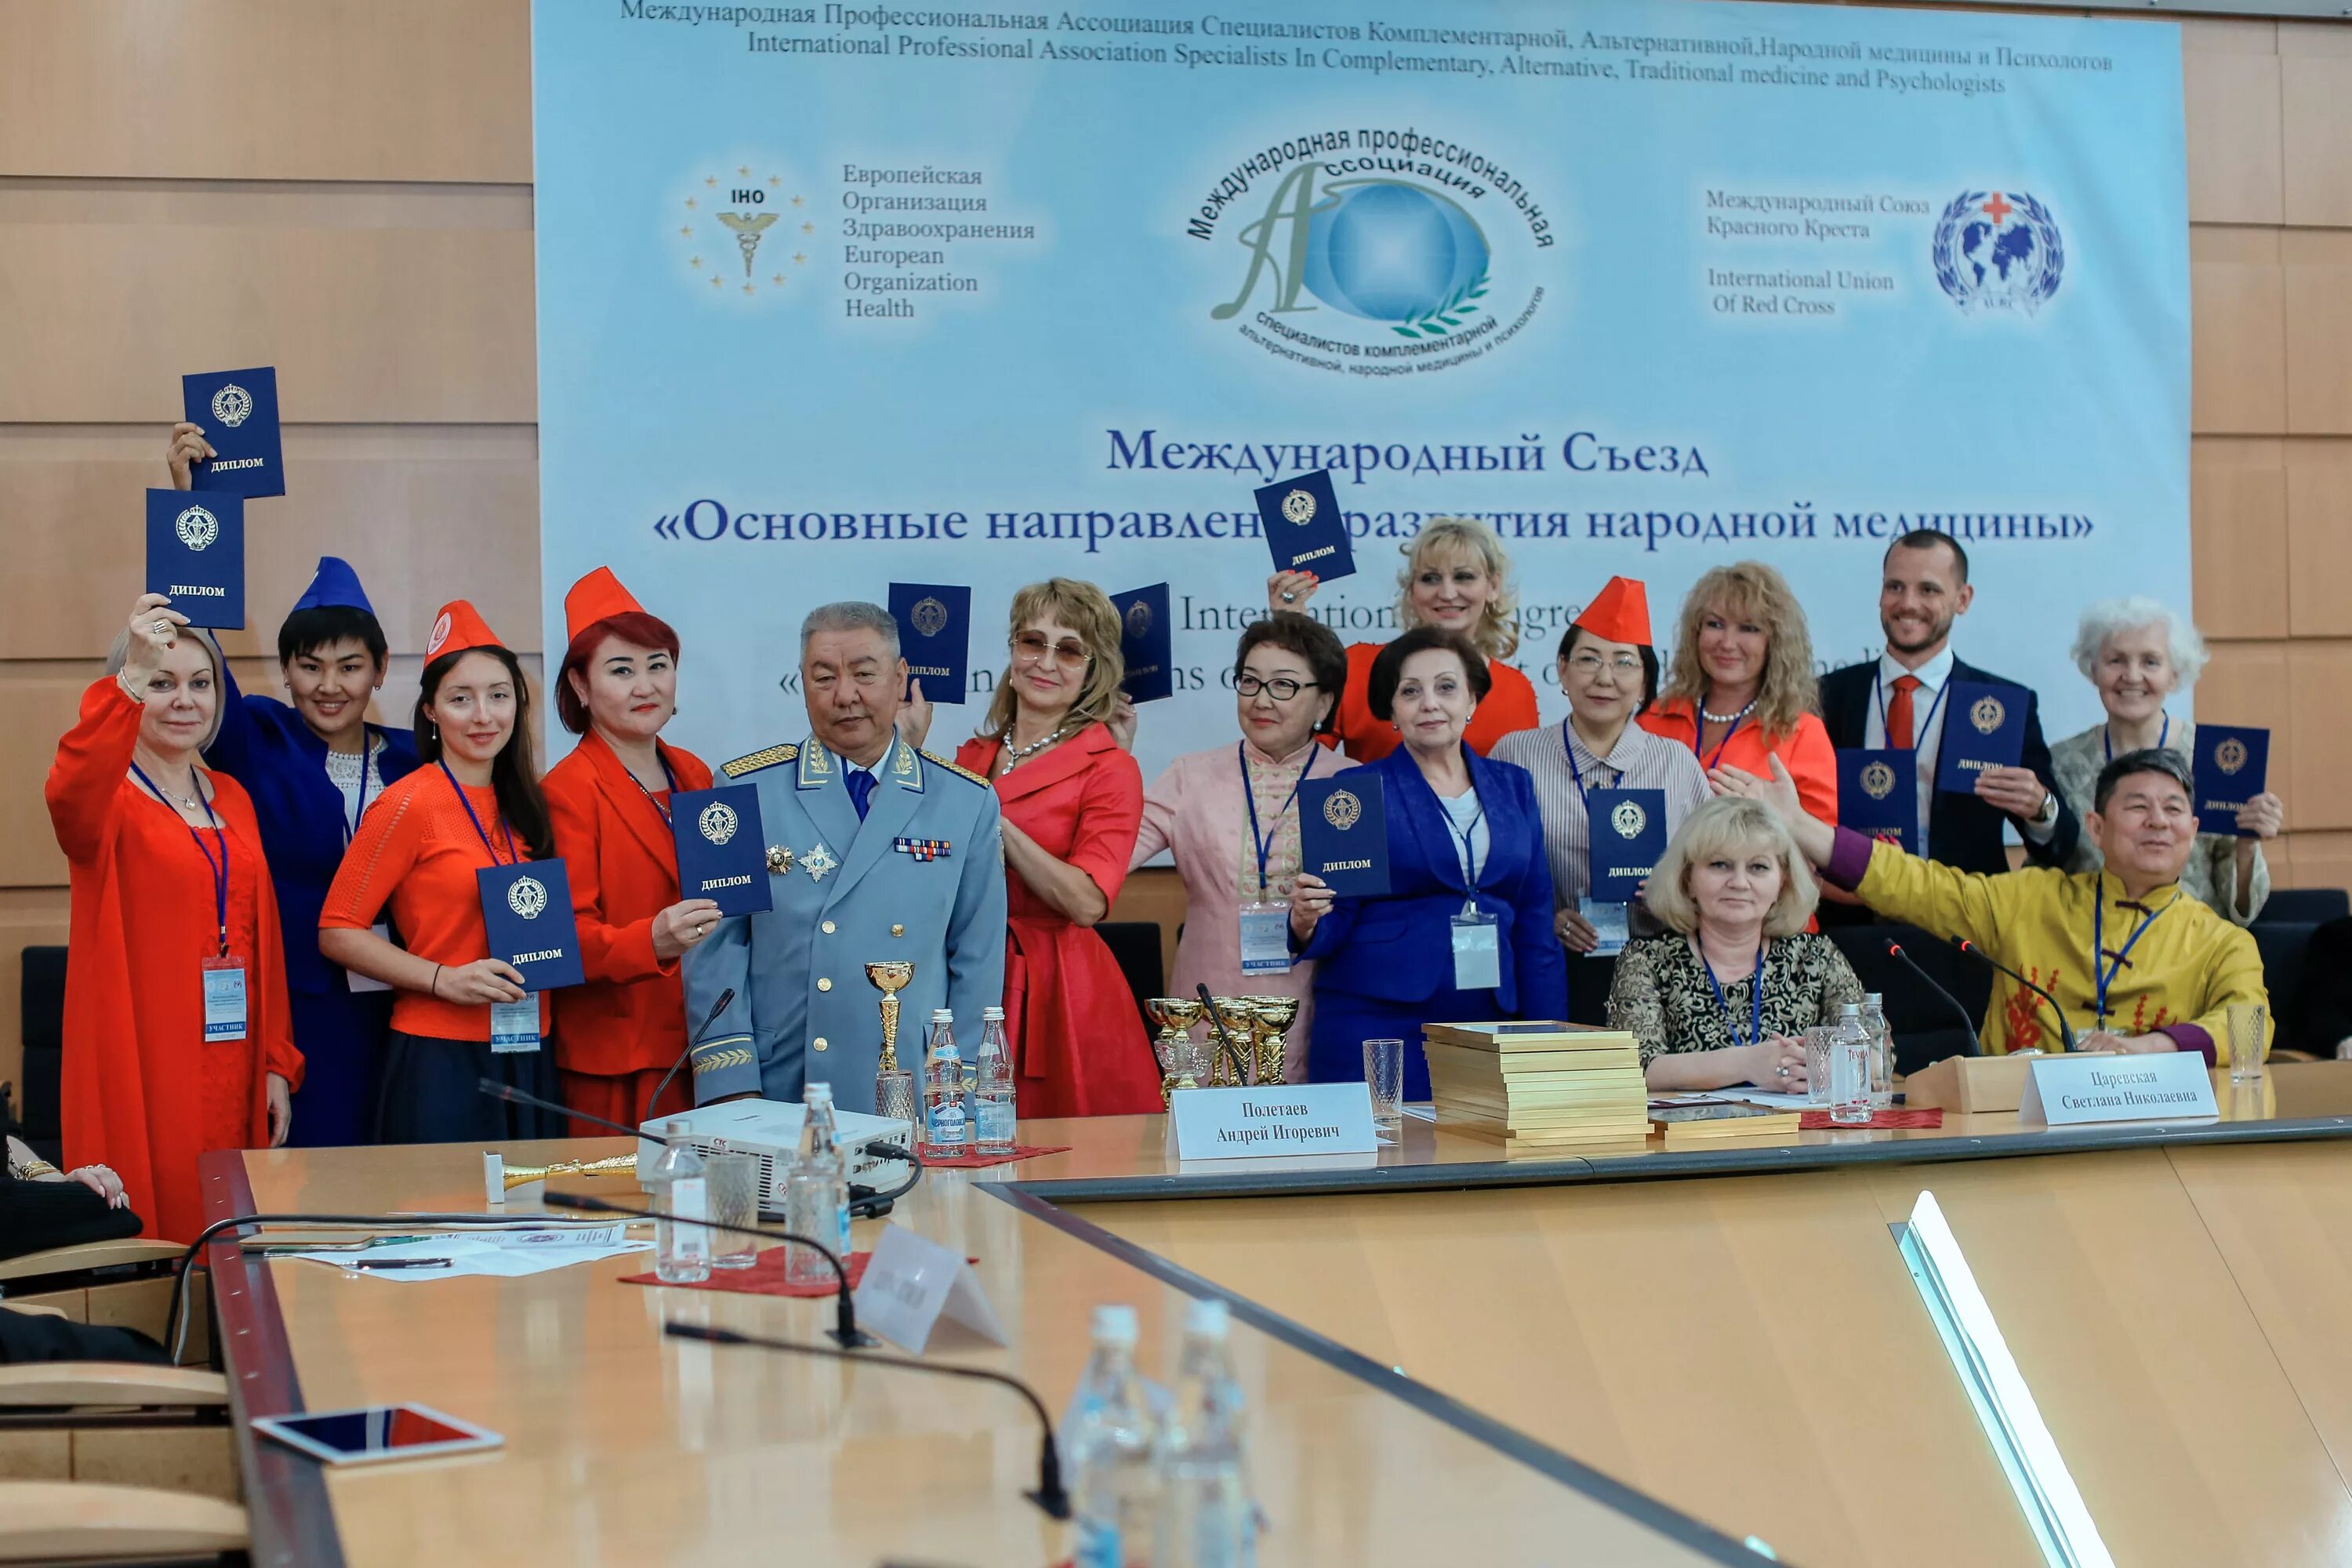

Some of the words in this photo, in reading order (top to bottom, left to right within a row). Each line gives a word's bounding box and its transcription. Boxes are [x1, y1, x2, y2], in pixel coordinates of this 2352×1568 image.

[621, 1, 815, 26] Международная
[825, 3, 1048, 31] Профессиональная
[1057, 12, 1193, 34] Ассоциация
[1201, 16, 1361, 40] Специалистов
[1369, 22, 1573, 51] Комплементарной,
[1869, 47, 1971, 65] медицины
[1979, 53, 1990, 65] и
[1995, 46, 2112, 71] Психологов
[748, 31, 890, 55] International
[898, 35, 1032, 58] Professional
[1040, 40, 1167, 63] Association
[1175, 44, 1288, 69] Specialists
[1296, 48, 1316, 67] In
[1323, 49, 1494, 78] Complementary,
[1501, 55, 1618, 79] Alternative,
[1625, 58, 1733, 82] Traditional
[1740, 65, 1828, 86] medicine
[1836, 68, 1870, 87] and
[1876, 69, 2005, 96] Psychologists
[843, 165, 982, 188] Европейская
[731, 189, 764, 205] IHO
[1187, 129, 1350, 241] Международная
[1359, 127, 1555, 249] профессиональная
[843, 193, 987, 214] Организация
[1706, 190, 1874, 216] Международный
[1880, 194, 1930, 215] Союз
[843, 220, 1036, 241] Здравоохранения
[1706, 216, 1799, 239] Красного
[1805, 219, 1870, 241] Креста
[845, 245, 944, 267] European
[845, 272, 978, 294] Organization
[1708, 268, 1831, 289] International
[1838, 271, 1894, 290] Union
[846, 299, 915, 318] Health
[1714, 294, 1736, 314] Of
[1742, 294, 1778, 314] Red
[1784, 296, 1835, 314] Cross
[1256, 310, 1360, 357] специалистов
[1364, 315, 1498, 358] комплементарной
[1348, 361, 1413, 378] народной
[1417, 348, 1483, 374] медицины
[1494, 285, 1545, 347] психологов
[211, 457, 263, 473] ДИПЛОМ
[1107, 430, 1544, 484] Международный
[1562, 432, 1709, 477] Съезд
[653, 499, 968, 542] «Основные
[986, 510, 1262, 552] направлен
[1587, 500, 1816, 551] народной
[1833, 512, 2094, 543] медицины»
[1292, 546, 1335, 565] ДИПЛОМ
[169, 585, 225, 597] ДИПЛОМ
[1323, 859, 1370, 873] ДИПЛОМ
[702, 875, 751, 891] ДИПЛОМ
[512, 949, 562, 966] ДИПЛОМ
[209, 1022, 243, 1032] УЧАСТНИК
[2091, 1071, 2158, 1087] Царевская
[1242, 1102, 1308, 1118] Полетаев
[2062, 1094, 2122, 1110] Светлана
[2125, 1090, 2198, 1105] Николаевна
[1217, 1127, 1269, 1145] Андрей
[1273, 1124, 1340, 1143] Игоревич
